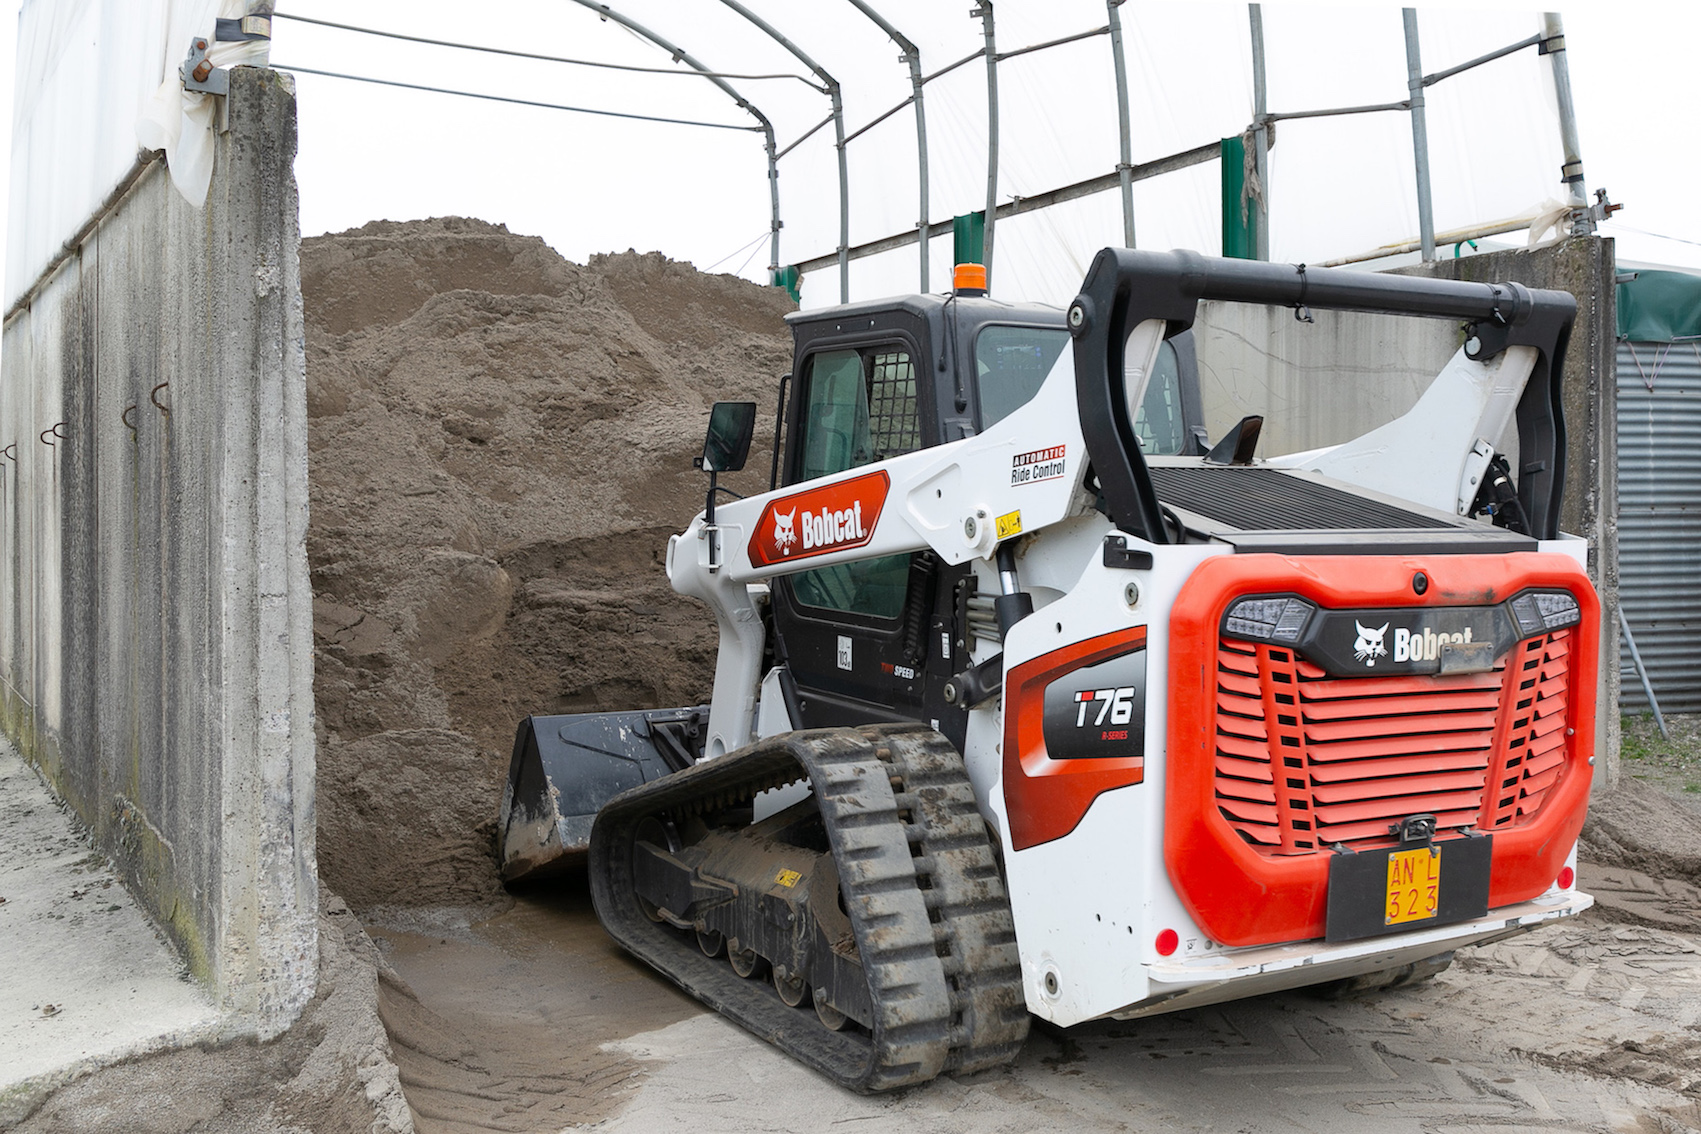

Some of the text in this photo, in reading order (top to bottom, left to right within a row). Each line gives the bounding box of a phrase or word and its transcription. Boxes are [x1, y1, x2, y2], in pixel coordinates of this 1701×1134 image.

[1013, 446, 1065, 467] AUTOMATIC
[1011, 459, 1065, 484] Ride Control
[801, 500, 863, 549] Bobcat
[894, 665, 914, 679] SPEED
[1074, 686, 1136, 728] T76
[1101, 730, 1128, 740] R-SERIES
[1389, 886, 1437, 918] 323
